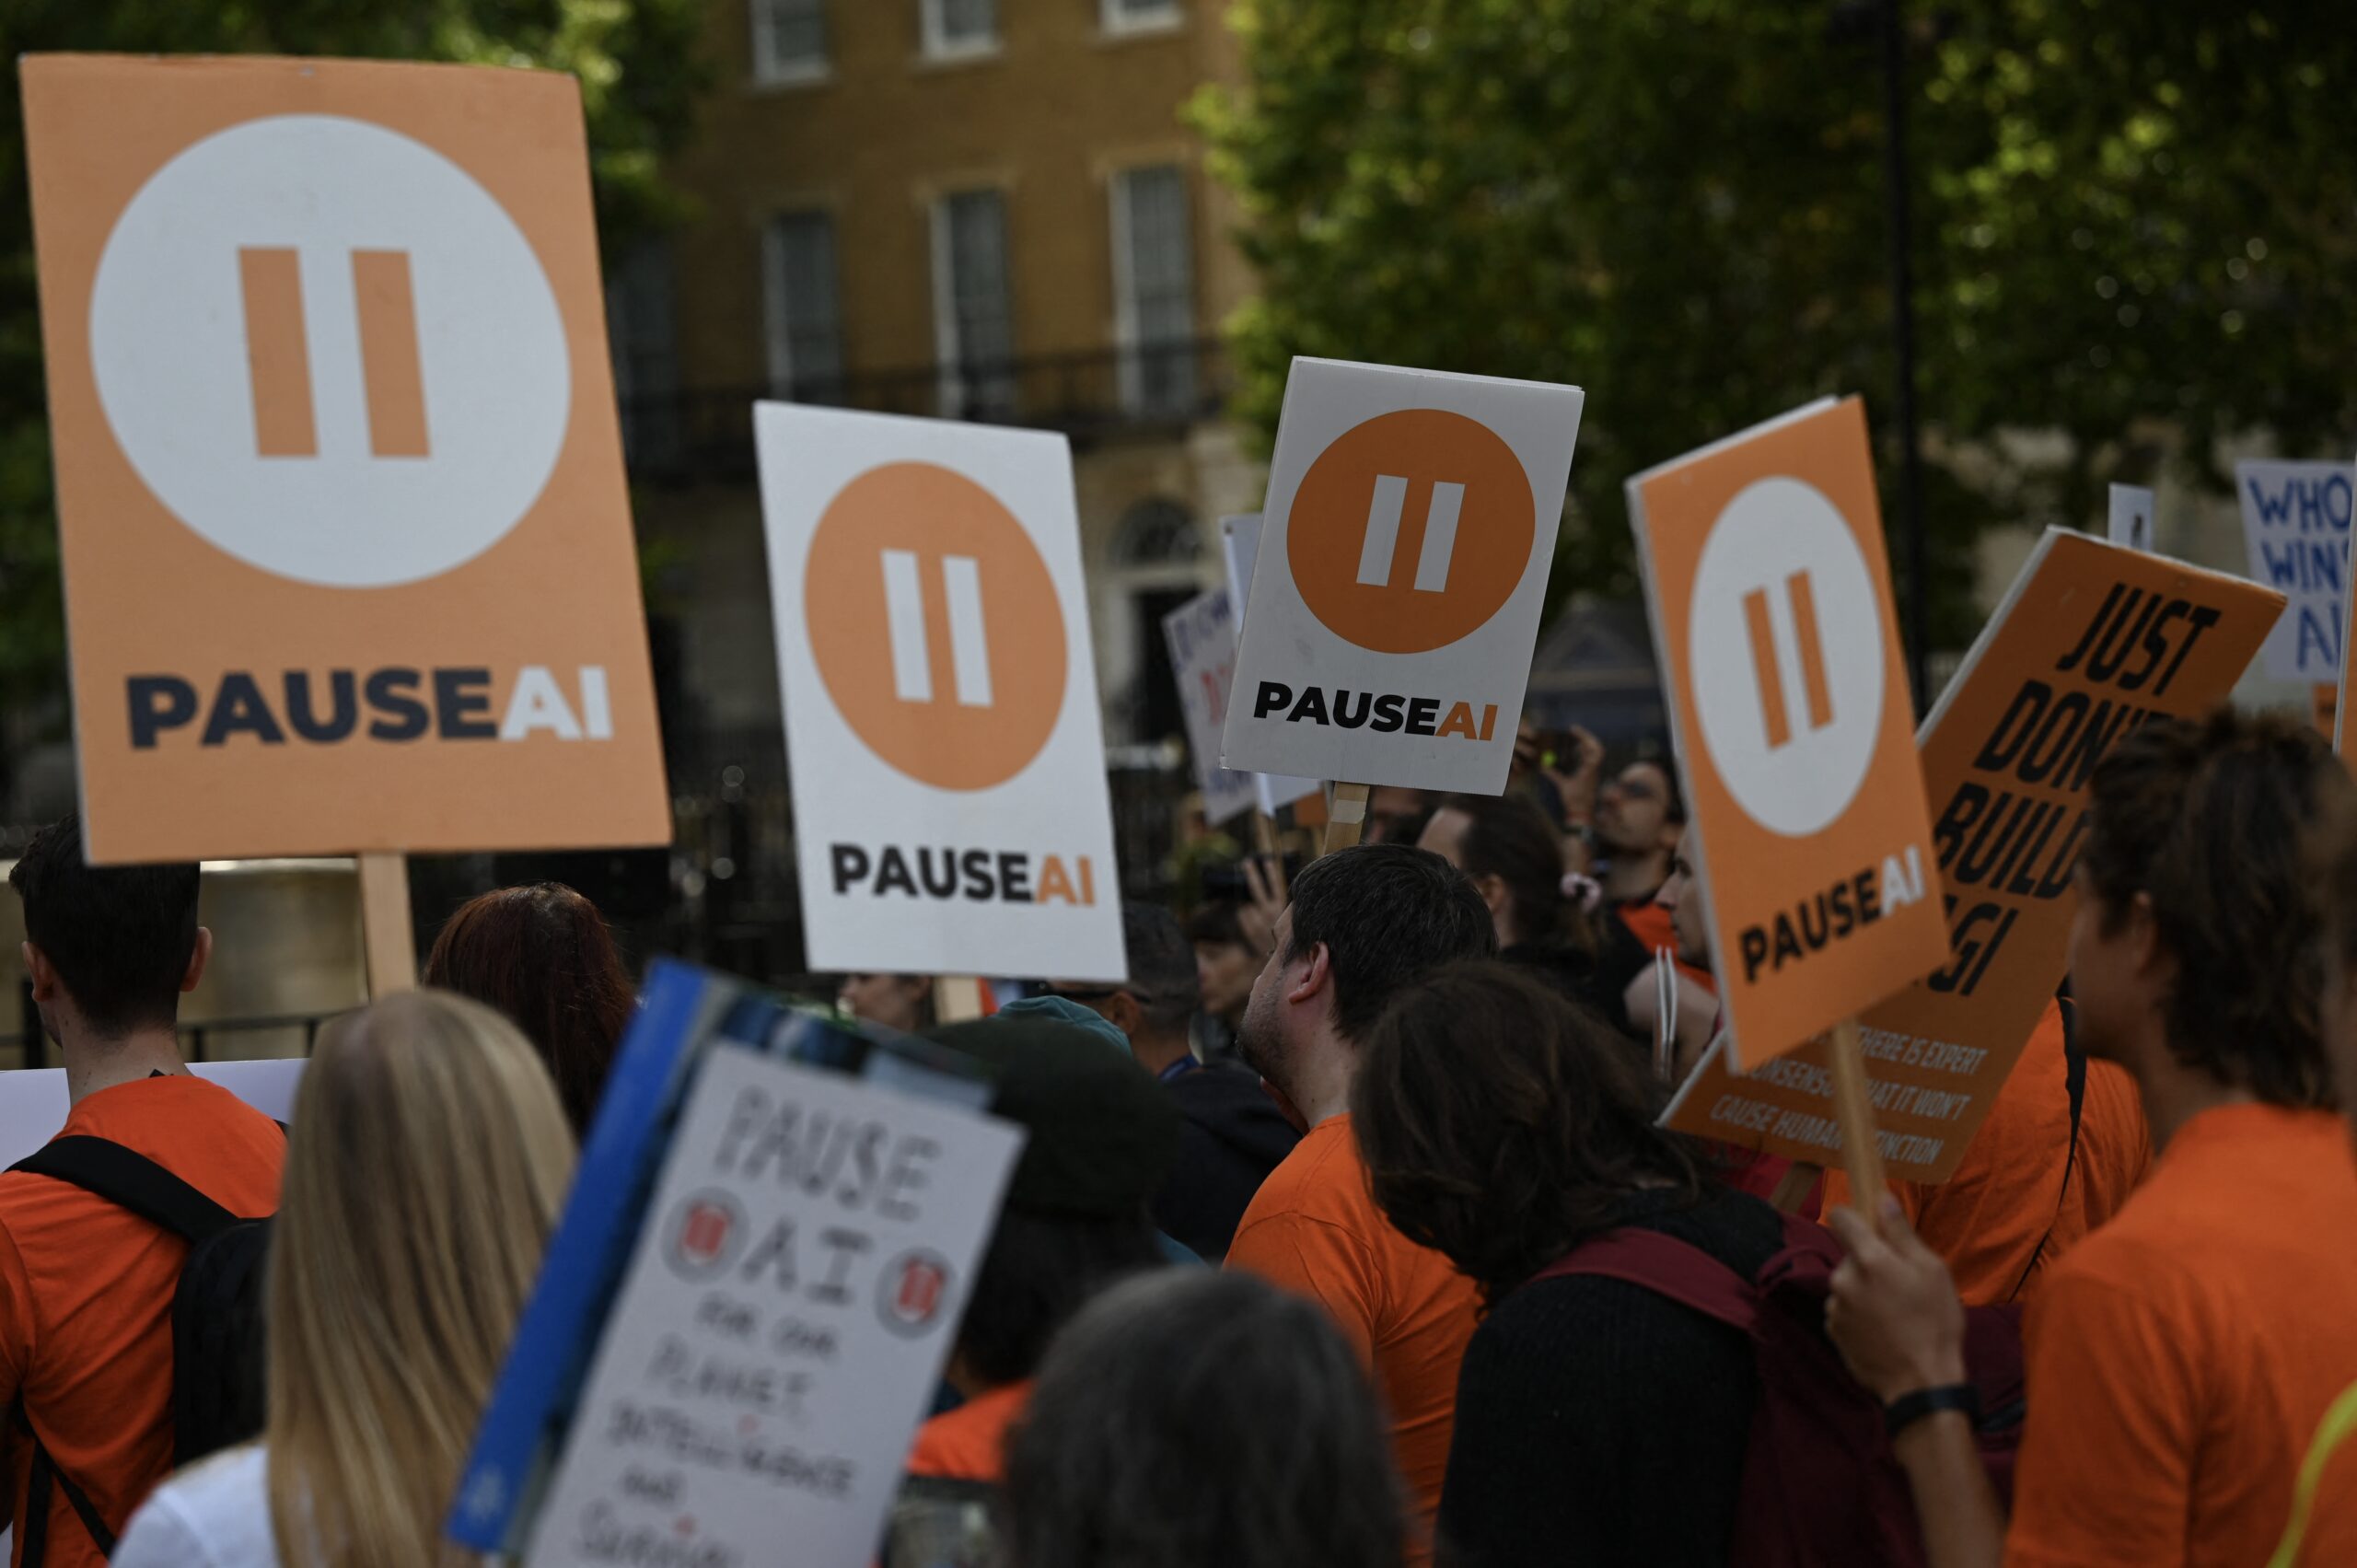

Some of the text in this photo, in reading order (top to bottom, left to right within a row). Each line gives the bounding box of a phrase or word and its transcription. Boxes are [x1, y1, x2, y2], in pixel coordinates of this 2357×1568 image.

[2261, 538, 2349, 592] WIN
[2055, 582, 2223, 697] JUST
[125, 665, 614, 750] PAUSEAI
[1252, 680, 1499, 742] PAUSEAI
[1972, 679, 2175, 793] DON'
[830, 842, 1097, 907] PAUSEAI
[1933, 782, 2090, 900] BUILD
[1739, 843, 1925, 984] PAUSEAI
[1926, 894, 2019, 996] GI
[1918, 1040, 1989, 1076] EXPERT
[713, 1085, 944, 1223] PAUSE
[1710, 1094, 1778, 1131] CAUSE
[738, 1214, 876, 1306] AI
